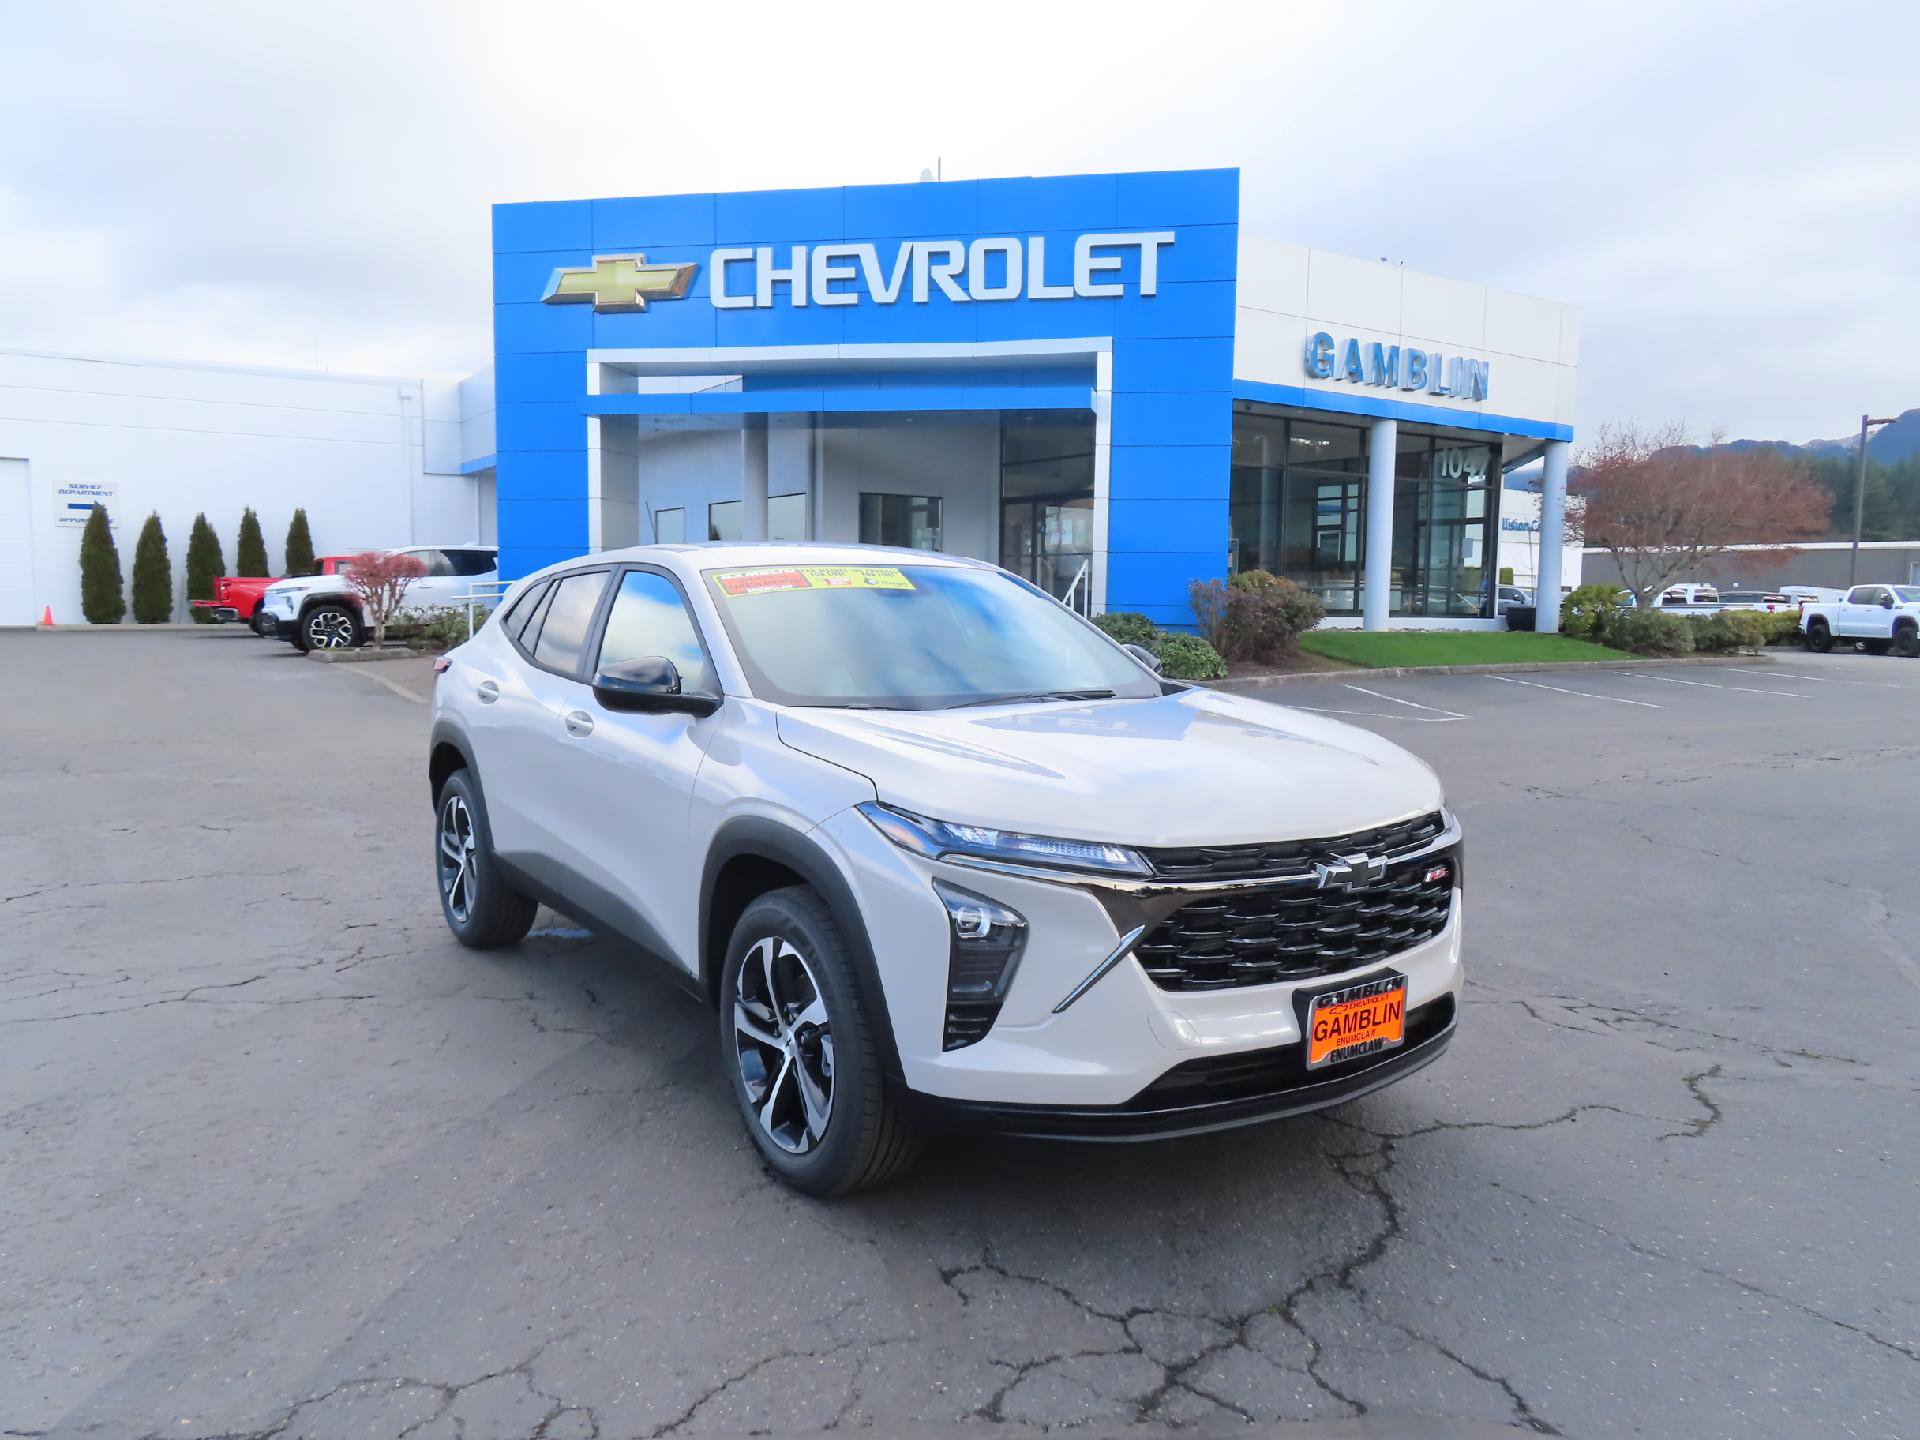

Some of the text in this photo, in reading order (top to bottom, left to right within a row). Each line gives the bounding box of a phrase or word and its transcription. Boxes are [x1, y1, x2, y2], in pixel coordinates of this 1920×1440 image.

[709, 231, 1175, 309] CHEVROLET
[1305, 331, 1489, 401] GAMBLIN
[58, 489, 113, 497] DEPARTMENT
[1313, 1001, 1400, 1042] GAMBLIN
[1336, 1029, 1376, 1047] ENUMCLAW
